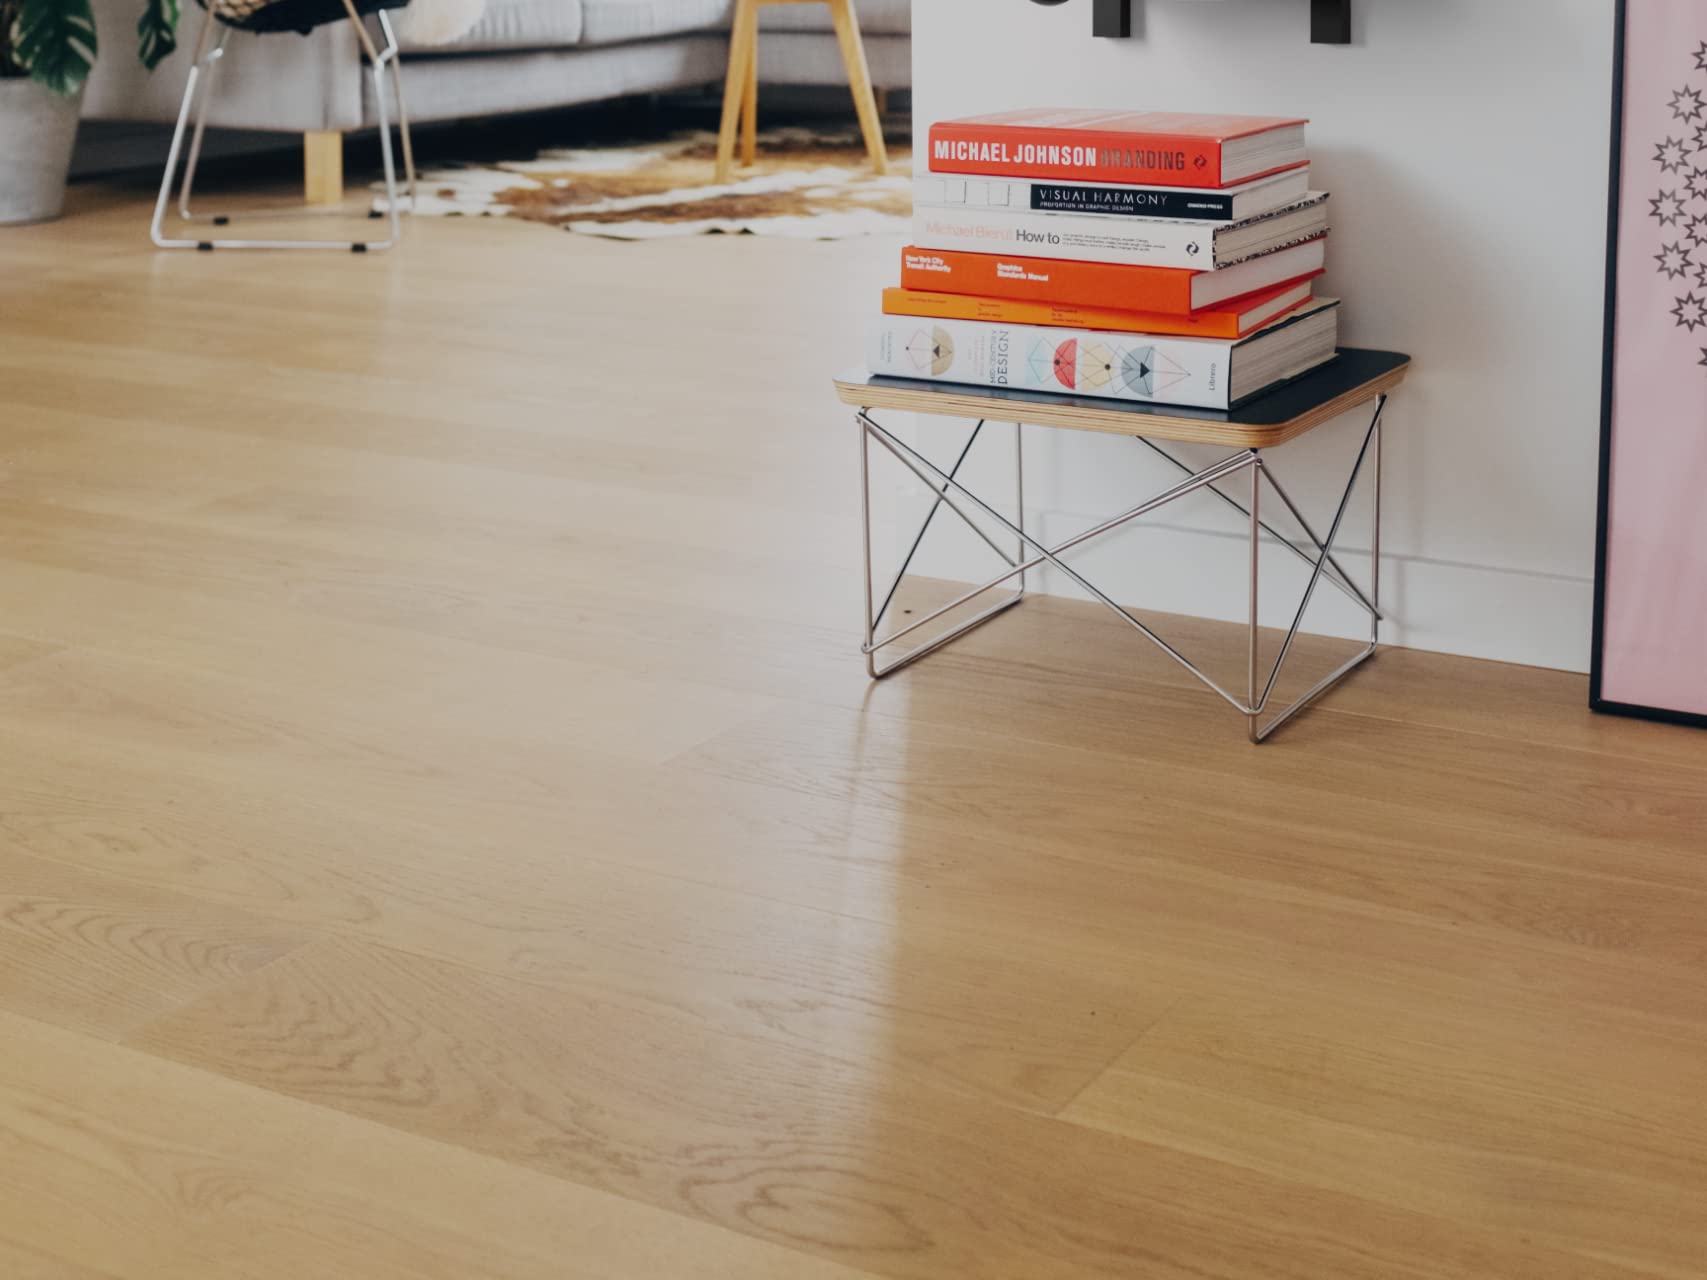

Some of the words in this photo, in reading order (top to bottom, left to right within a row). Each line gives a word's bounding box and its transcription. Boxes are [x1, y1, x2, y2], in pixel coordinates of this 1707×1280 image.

[934, 140, 1010, 163] MICHAEL
[1013, 144, 1097, 167] JOHNSON
[1101, 149, 1185, 170] BRANDING
[1040, 189, 1087, 202] VISUAL
[1094, 191, 1168, 206] HARMONY
[1016, 229, 1045, 243] How
[1047, 231, 1061, 244] to
[997, 330, 1009, 385] DESIGN
